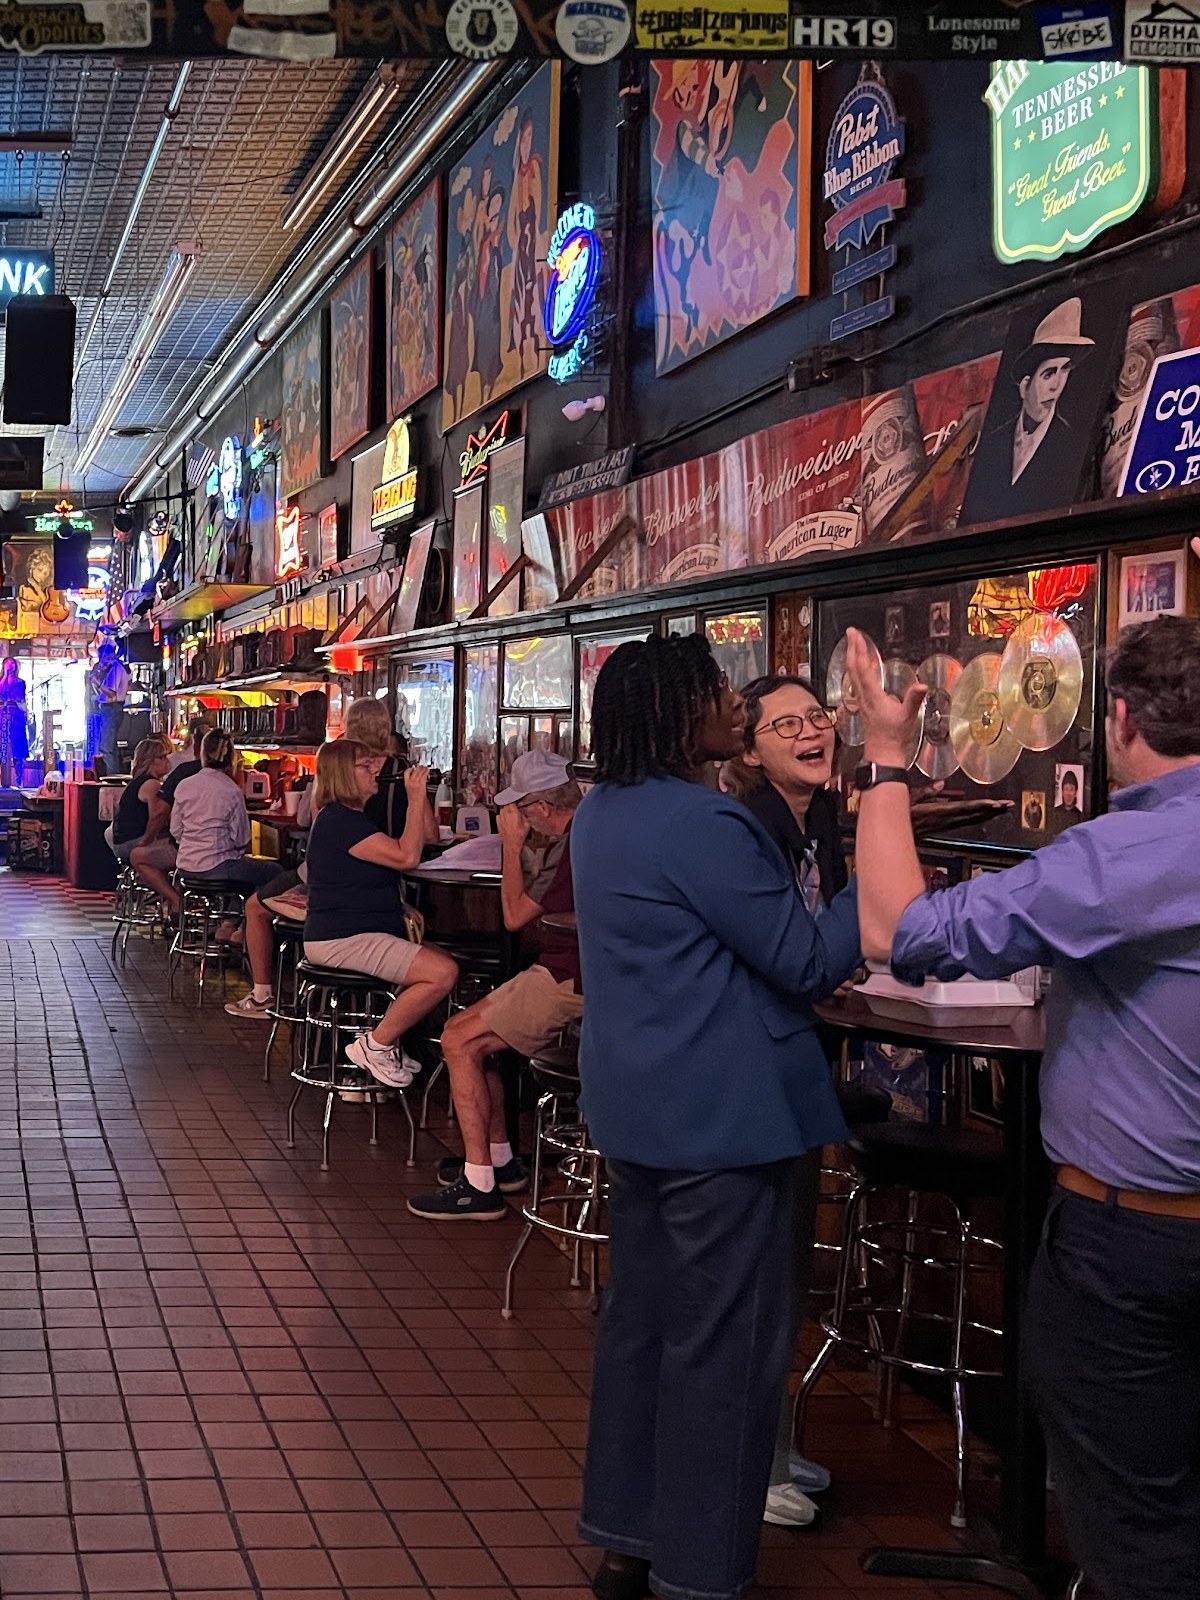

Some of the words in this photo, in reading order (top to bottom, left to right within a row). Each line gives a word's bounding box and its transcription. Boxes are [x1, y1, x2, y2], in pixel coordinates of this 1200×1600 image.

[794, 18, 894, 47] HR19
[928, 15, 1021, 31] Lonesome
[951, 34, 997, 54] Style
[837, 103, 880, 158] Pabst
[1041, 96, 1094, 140] BEER
[823, 166, 851, 200] Blue
[851, 137, 900, 181] Ribbon
[850, 176, 873, 195] BEER
[1041, 178, 1080, 222] Great
[607, 447, 630, 470] ART
[748, 432, 874, 517] Budweiser
[818, 521, 852, 542] Lager
